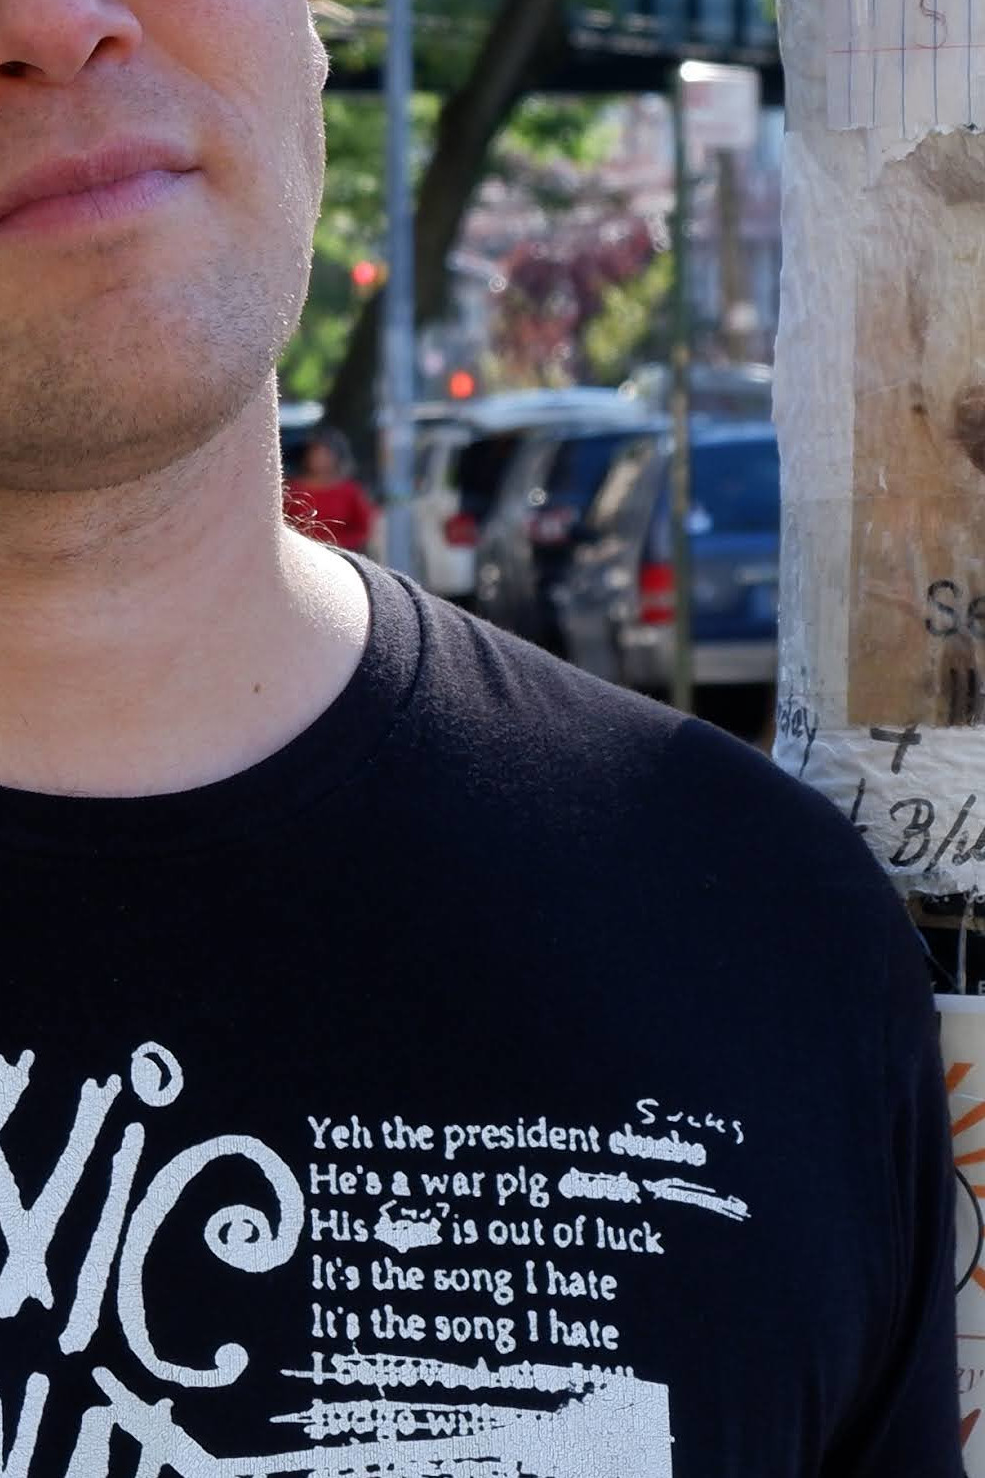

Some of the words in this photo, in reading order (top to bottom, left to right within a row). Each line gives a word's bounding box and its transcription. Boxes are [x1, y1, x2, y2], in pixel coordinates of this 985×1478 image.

[308, 1116, 373, 1150] Yeh
[381, 1116, 435, 1151] the
[443, 1116, 602, 1160] president
[310, 1163, 383, 1196] He's
[392, 1171, 411, 1197] a
[420, 1171, 486, 1198] war
[497, 1165, 550, 1208] pig
[311, 1208, 369, 1243] His
[452, 1213, 479, 1245] is
[488, 1217, 545, 1246] out
[553, 1215, 587, 1249] of
[596, 1217, 665, 1255] luck
[312, 1254, 361, 1291] It's
[371, 1256, 425, 1291] the
[433, 1268, 514, 1306] song
[526, 1260, 538, 1295] I
[546, 1260, 618, 1301] hate
[312, 1302, 361, 1340] It's
[370, 1304, 427, 1341] the
[434, 1315, 517, 1355] song
[527, 1310, 539, 1342] I
[549, 1308, 620, 1350] hate
